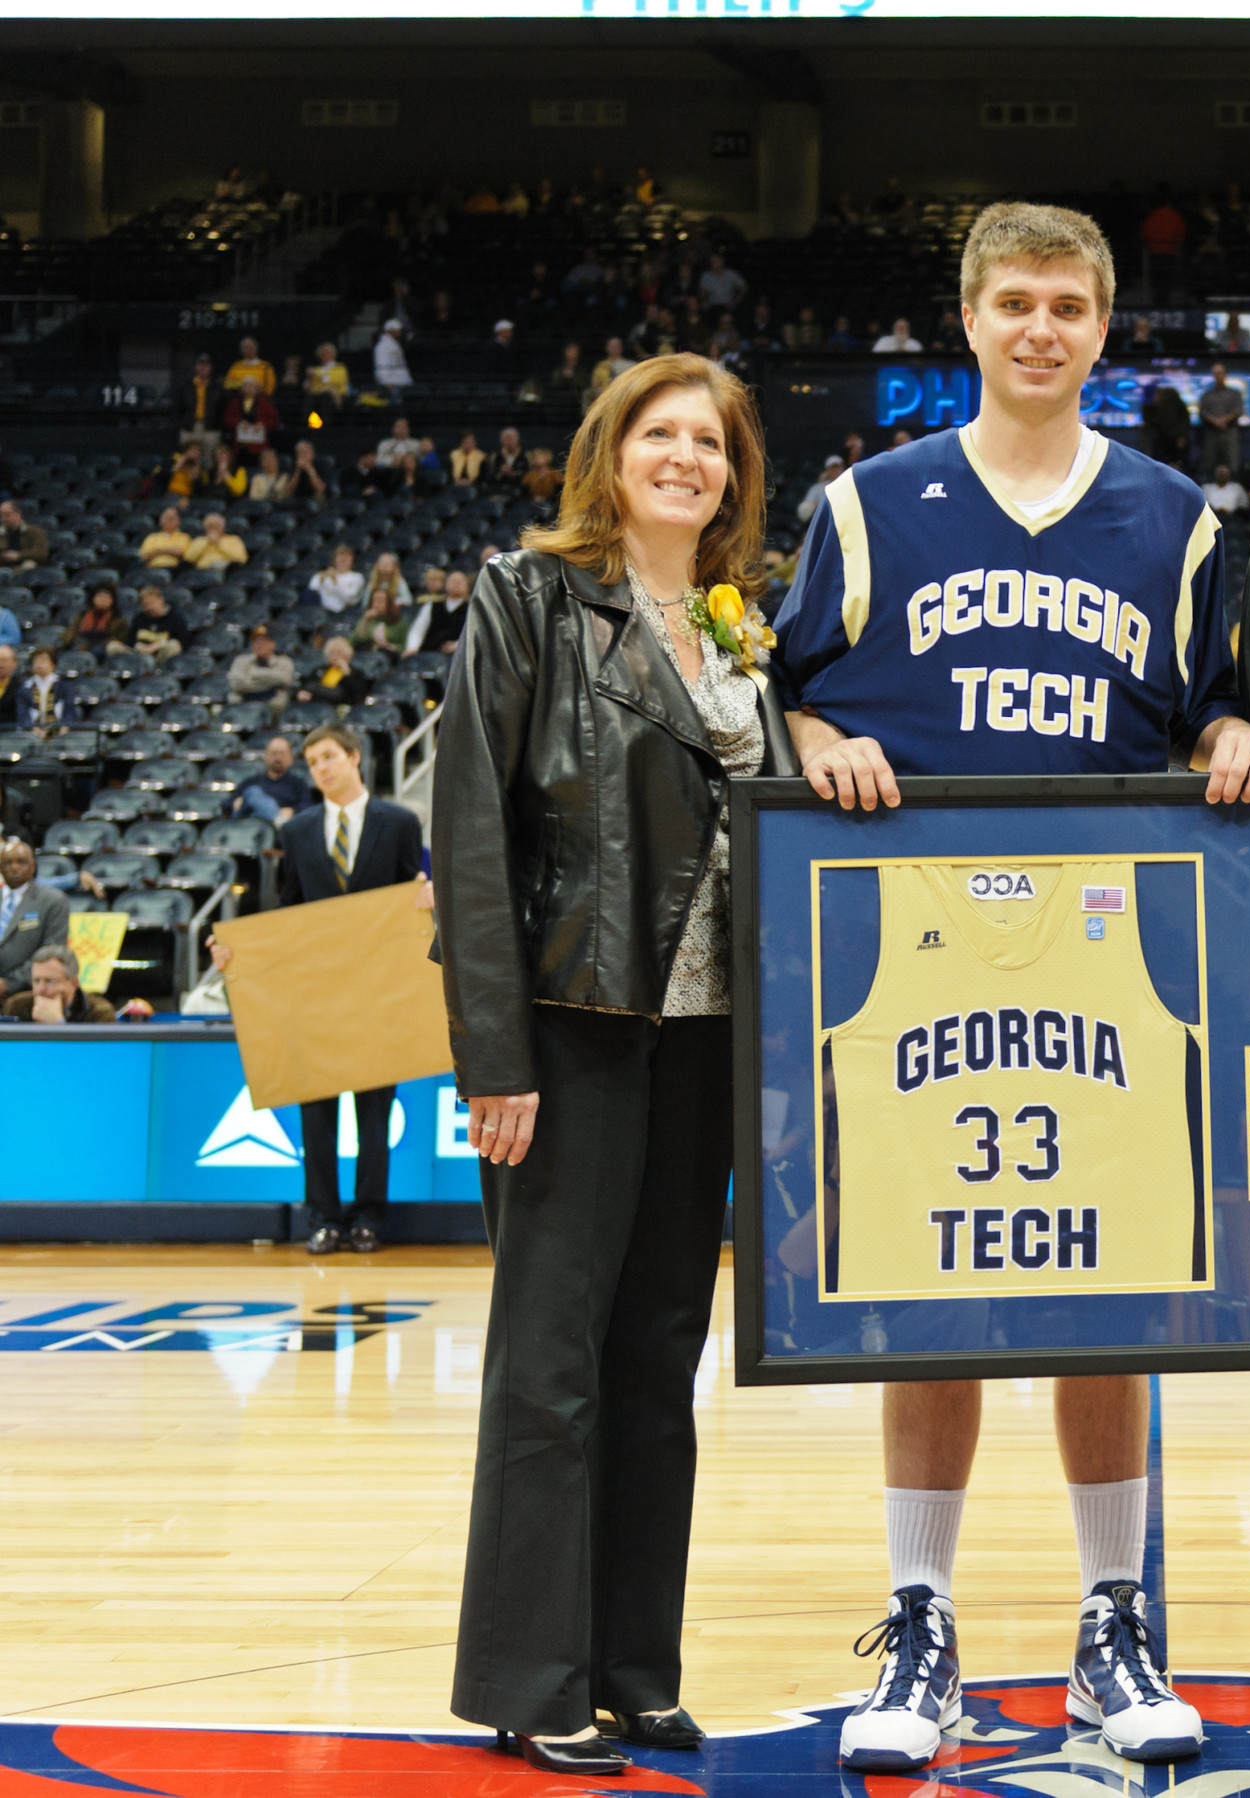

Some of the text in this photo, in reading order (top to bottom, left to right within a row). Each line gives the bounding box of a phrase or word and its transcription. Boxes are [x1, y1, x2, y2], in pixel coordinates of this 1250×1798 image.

[178, 310, 259, 329] 210-211
[1109, 311, 1185, 328] 211212
[102, 386, 138, 406] 114
[906, 567, 1152, 681] GEORGIA
[950, 666, 1110, 743] TECH
[894, 1006, 1131, 1094] GEORGIA
[953, 1104, 1061, 1185] 33
[929, 1205, 1099, 1272] TECH
[0, 1300, 439, 1327] IPS
